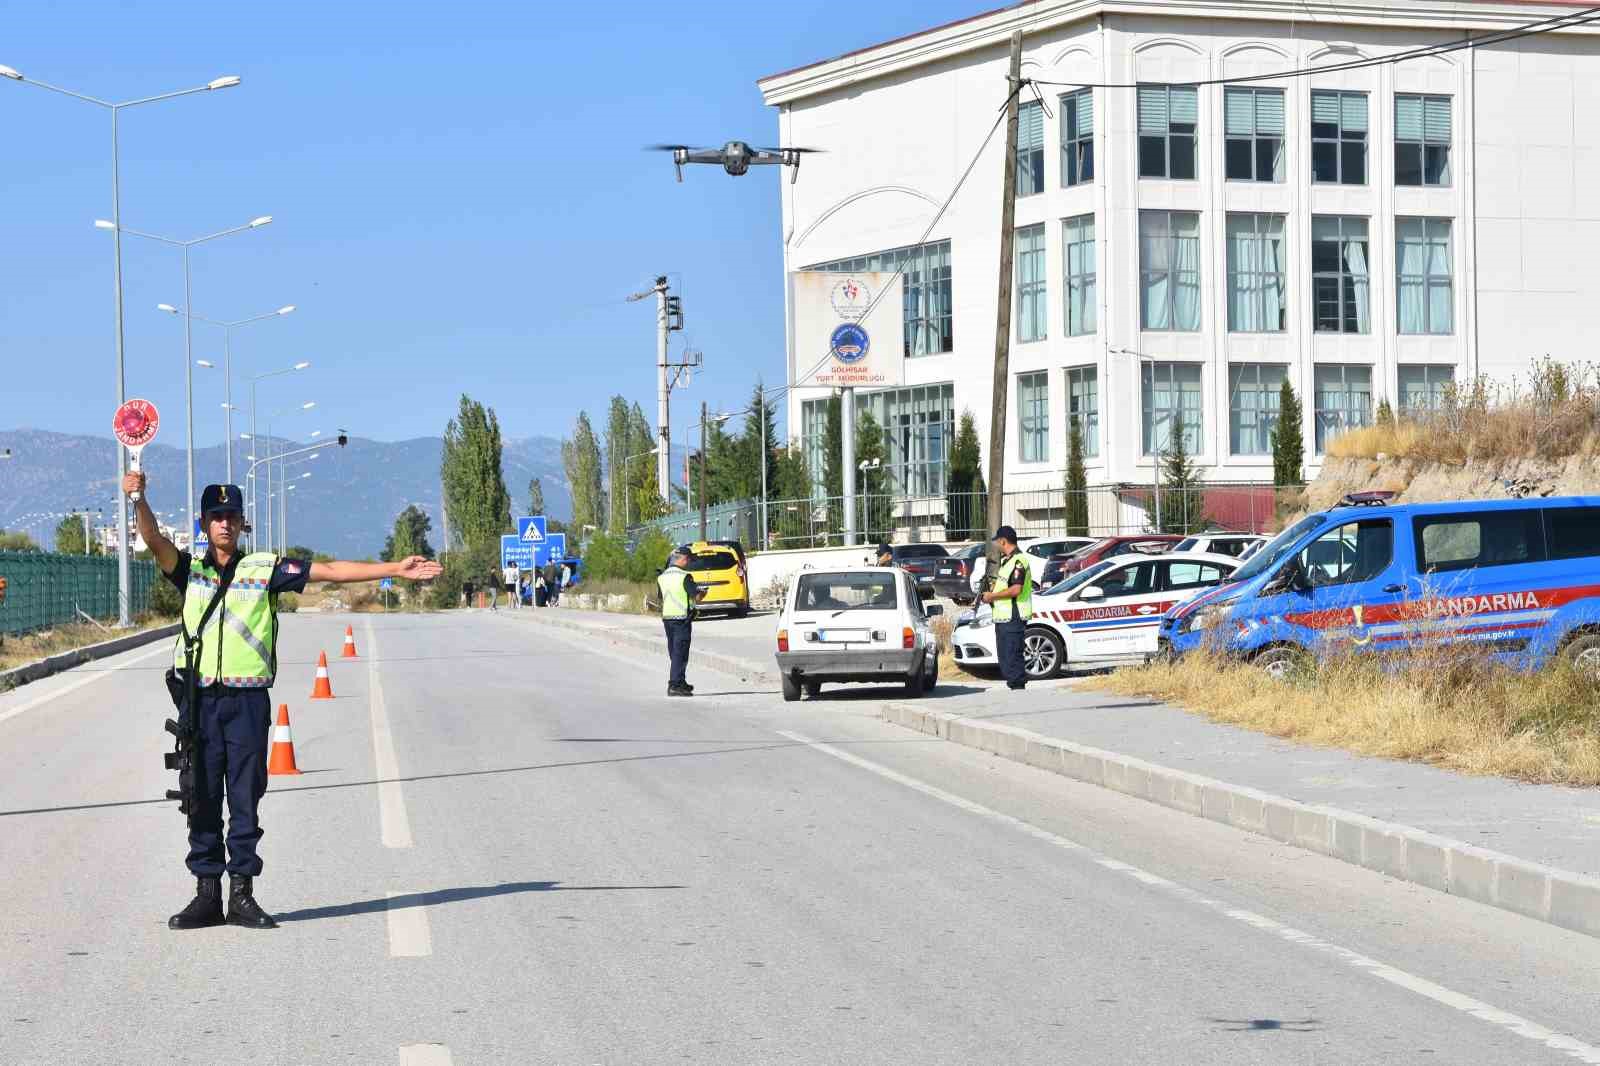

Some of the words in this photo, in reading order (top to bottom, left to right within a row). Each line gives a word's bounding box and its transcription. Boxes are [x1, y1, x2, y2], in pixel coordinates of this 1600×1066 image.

[123, 401, 148, 411] DUR
[114, 420, 158, 445] JANDARMA
[1080, 605, 1132, 620] JANDARMA
[1422, 591, 1540, 618] JANDARMA
